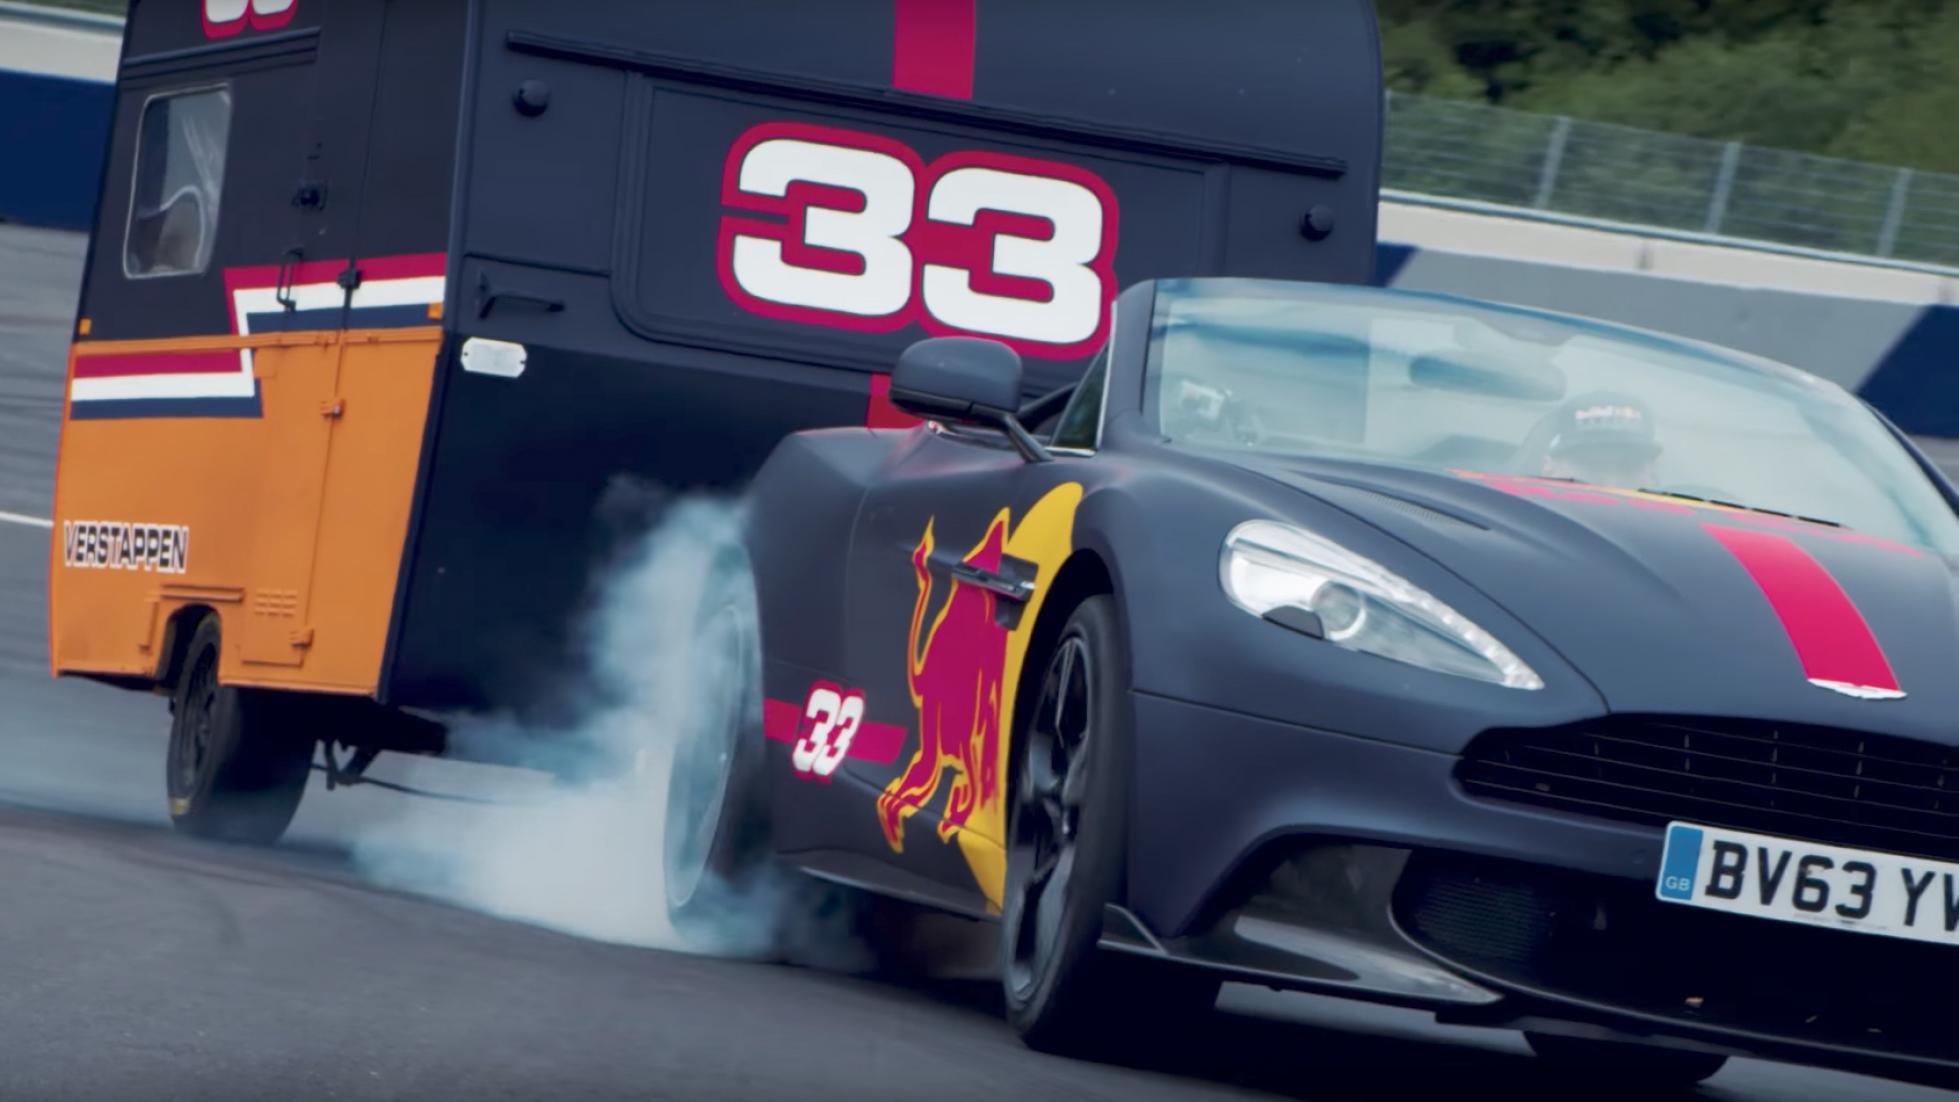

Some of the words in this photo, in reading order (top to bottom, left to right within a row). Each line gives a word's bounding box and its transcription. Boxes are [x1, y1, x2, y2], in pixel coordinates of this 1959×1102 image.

[730, 136, 1104, 346] 33
[64, 520, 189, 574] VERSTAPPEN
[792, 687, 864, 776] 33
[1665, 875, 1691, 892] GB
[1704, 839, 1878, 920] BV63
